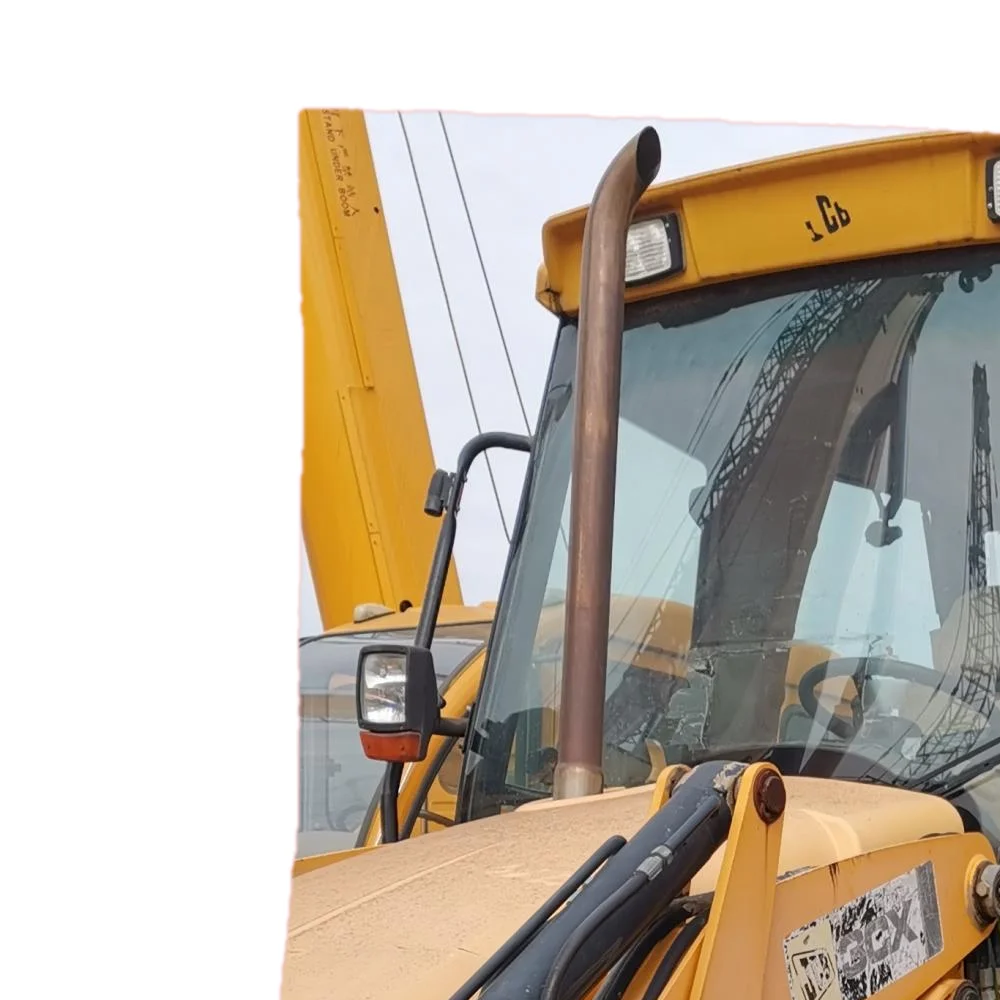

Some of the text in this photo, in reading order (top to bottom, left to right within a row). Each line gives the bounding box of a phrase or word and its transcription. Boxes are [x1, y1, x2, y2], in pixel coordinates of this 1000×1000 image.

[330, 148, 344, 182] UNDER
[338, 187, 352, 217] BOOM
[837, 899, 918, 979] 3CX
